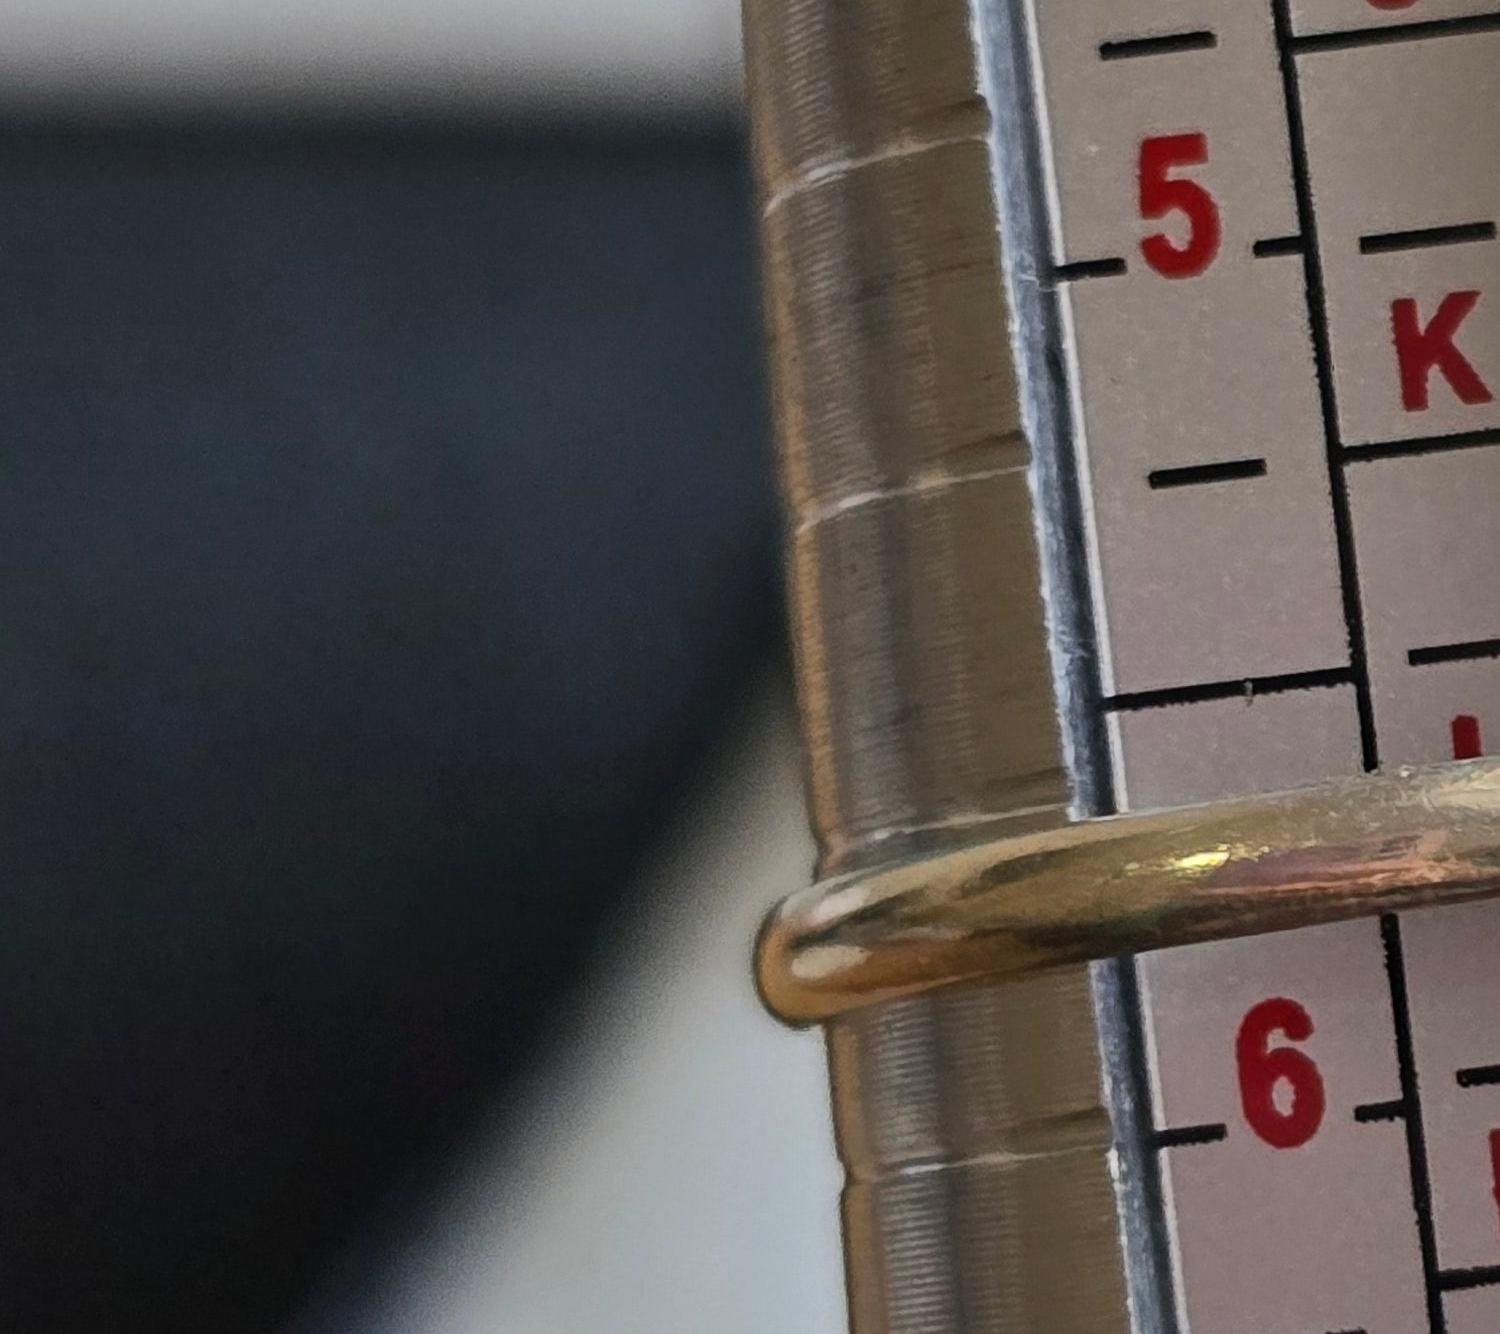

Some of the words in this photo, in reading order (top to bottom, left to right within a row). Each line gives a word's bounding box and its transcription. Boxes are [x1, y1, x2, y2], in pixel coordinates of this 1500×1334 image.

[1137, 132, 1222, 279] 5
[1391, 291, 1494, 410] K
[1234, 996, 1326, 1151] 6
